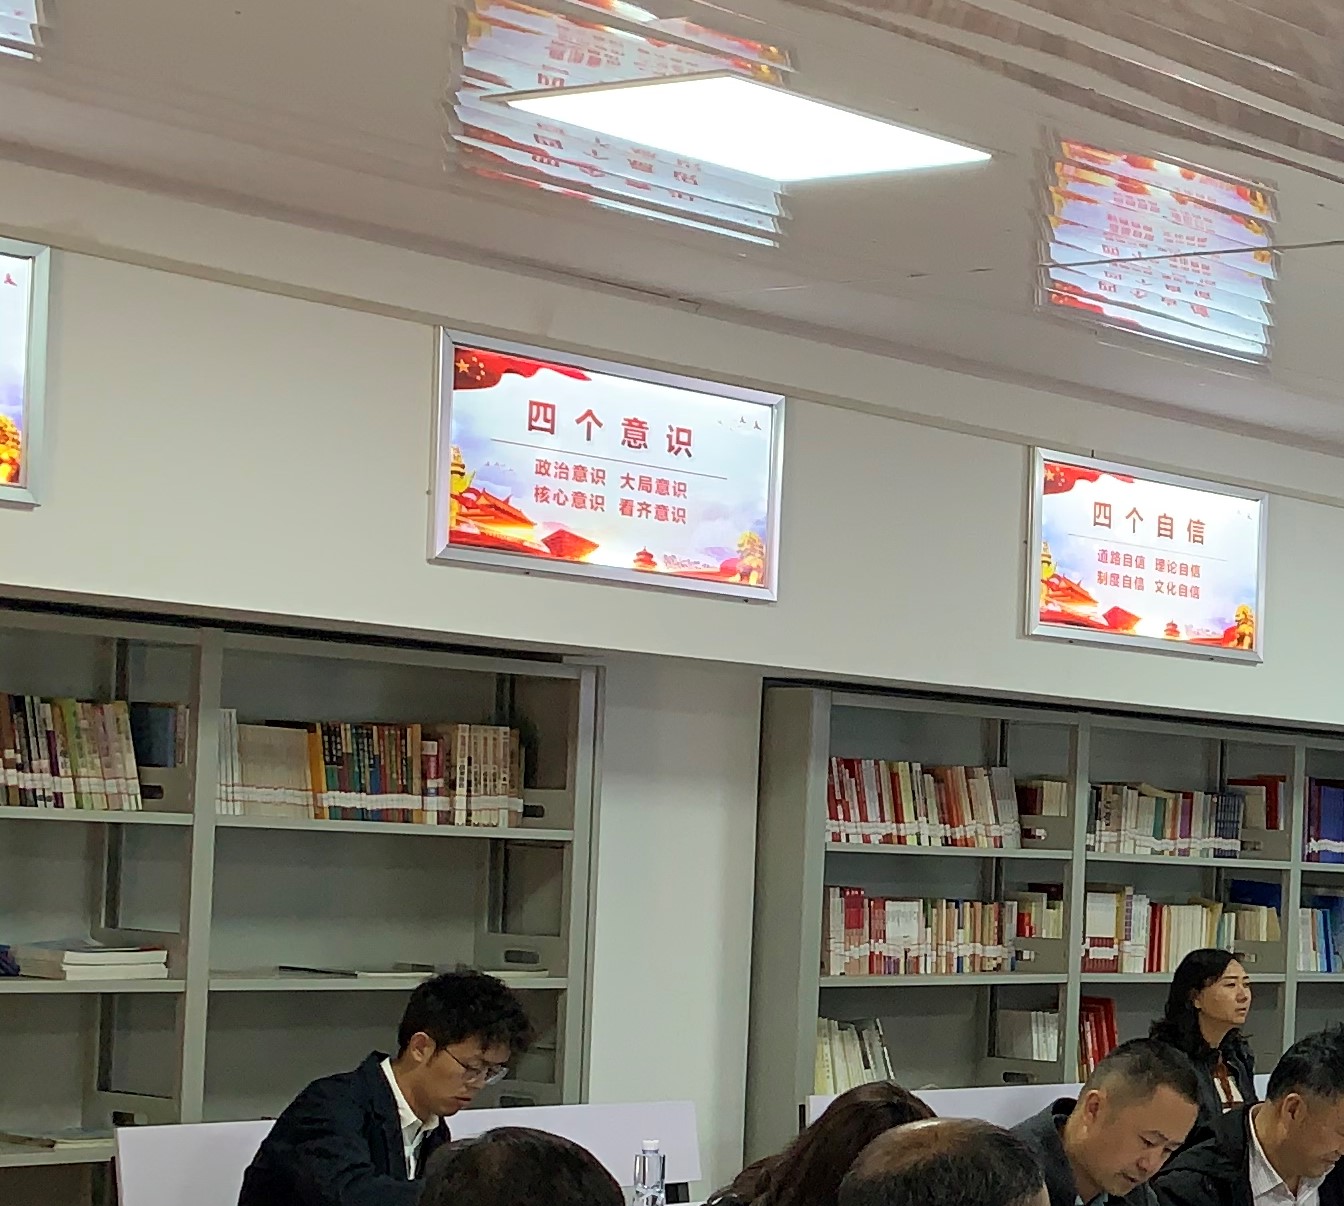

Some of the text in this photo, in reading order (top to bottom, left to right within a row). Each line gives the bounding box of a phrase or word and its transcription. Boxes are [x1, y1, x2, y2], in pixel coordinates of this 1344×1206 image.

[528, 399, 693, 459] 四个意识
[535, 458, 688, 500] 政治意识 大局意识
[534, 484, 687, 525] 核心意识 看齐意识
[1093, 501, 1206, 545] 四个自信
[1097, 549, 1201, 579] 道路自信 理论自信
[1097, 570, 1200, 600] 制度自信 文化自信
